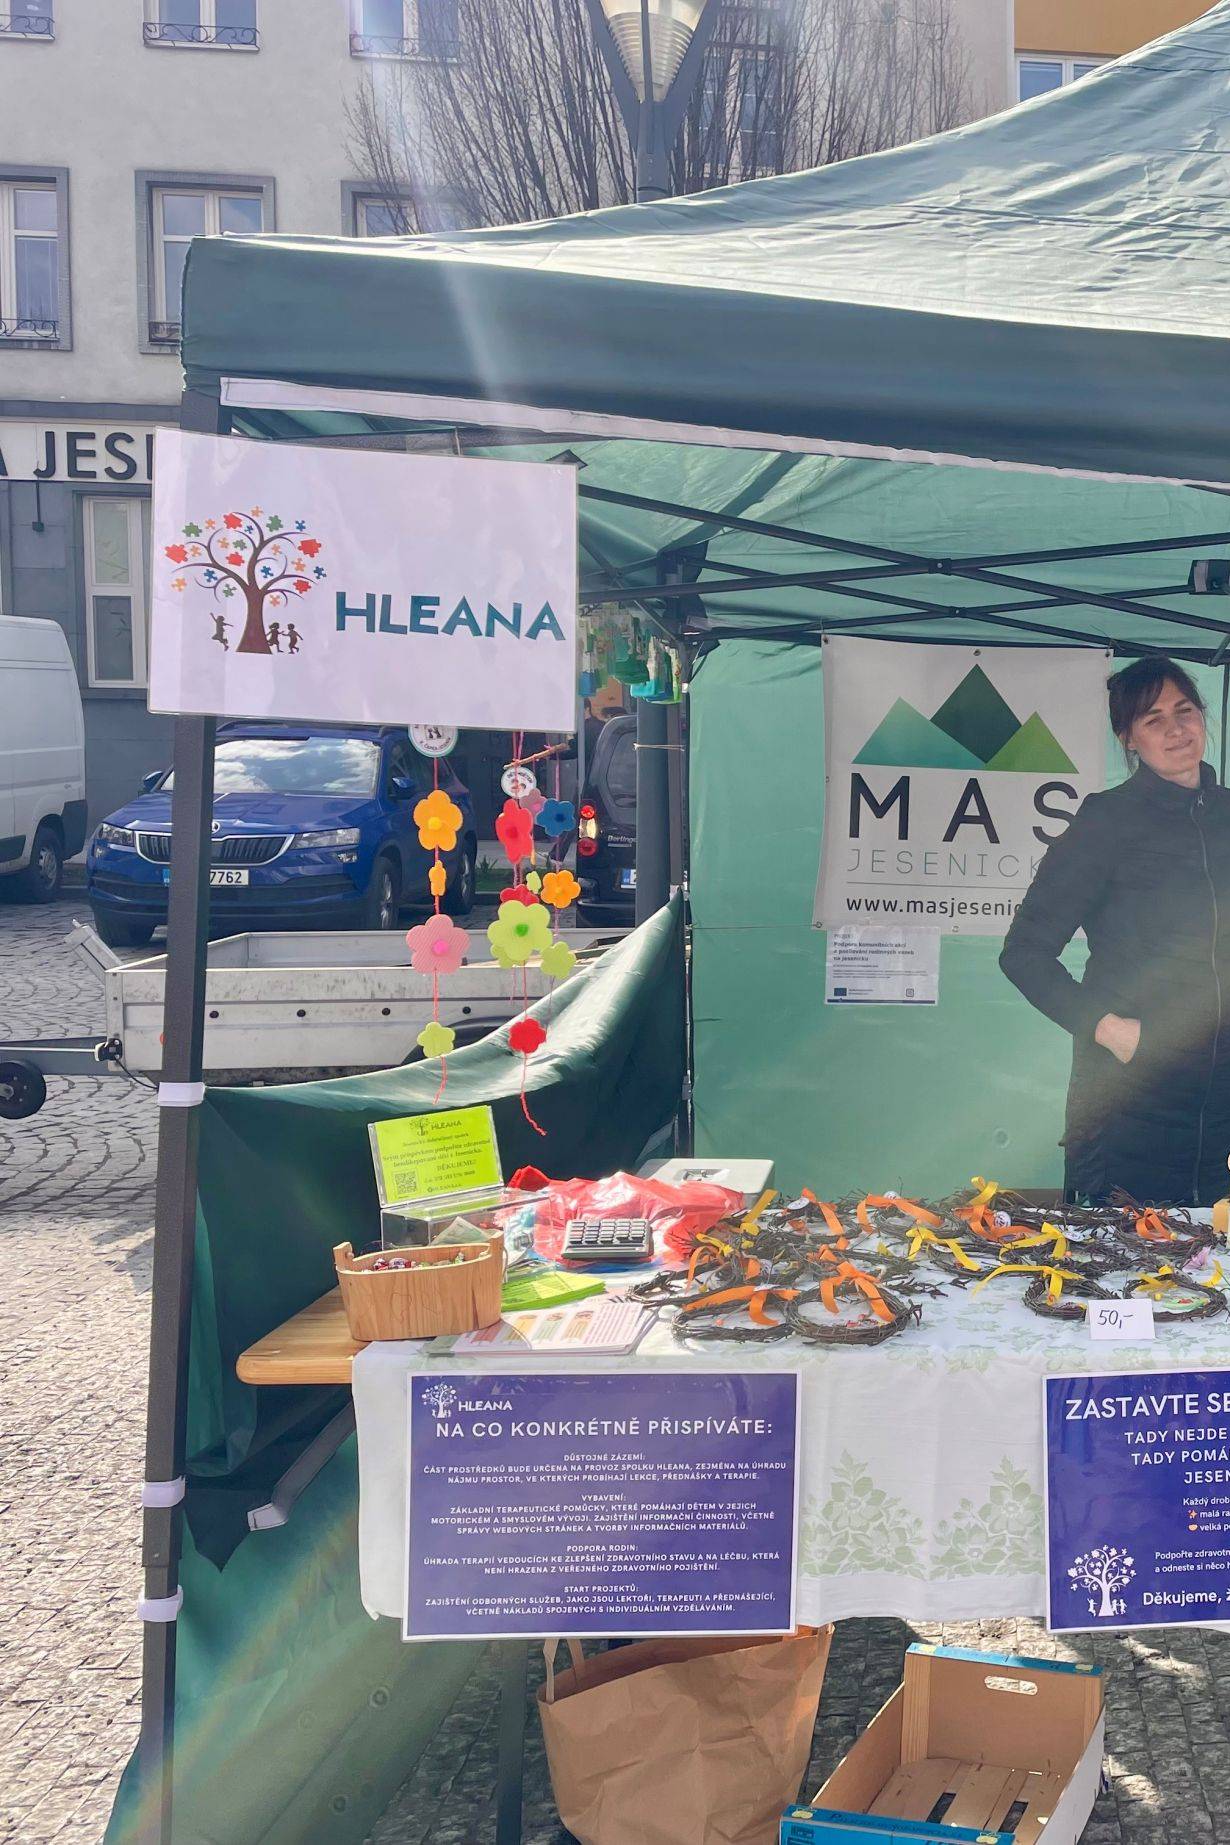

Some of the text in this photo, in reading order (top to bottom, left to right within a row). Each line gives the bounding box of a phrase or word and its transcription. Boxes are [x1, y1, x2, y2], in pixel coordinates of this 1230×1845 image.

[335, 592, 566, 641] HLEANA
[849, 772, 1079, 847] MAS
[210, 871, 242, 884] 7762
[458, 1400, 512, 1411] HLEANA
[1065, 1393, 1199, 1420] ZASTAVTE
[436, 1416, 772, 1437] NA CO KONKRÉTNĚ PŘISPÍVÁTE:
[1124, 1430, 1168, 1444] TADY
[1174, 1427, 1227, 1442] NEJDE
[564, 1452, 645, 1461] DŮSTOJNÉ ZÁZEMÍ:
[1131, 1451, 1175, 1465] TADY
[423, 1465, 446, 1473] ČÁST
[448, 1464, 505, 1473] PROSTŘEDKŮ
[533, 1464, 568, 1472] URČENA
[656, 1463, 692, 1473] HLEANA,
[695, 1461, 735, 1469] ZEJMÉNA
[752, 1460, 786, 1469] ÚHRADU
[581, 1492, 626, 1501] VYBAVENÍ:
[1183, 1497, 1208, 1507] Každý
[450, 1505, 494, 1514] ZÁKLADNÍ
[496, 1503, 560, 1512] TERAPEUTICKÉ
[563, 1503, 608, 1513] POMŮCKY,
[611, 1502, 638, 1511] KTERÉ
[640, 1502, 684, 1511] POMÁHAJÍ
[687, 1502, 716, 1510] DĚTEM
[726, 1502, 756, 1511] JEJICH
[1199, 1509, 1220, 1518] malá
[1199, 1522, 1222, 1531] velká
[566, 1544, 606, 1553] PODPORA
[1155, 1549, 1193, 1560] Podpořte
[423, 1557, 459, 1565] ÚHRADA
[461, 1556, 494, 1564] TERAPIÍ
[496, 1555, 548, 1564] VEDOUCÍCH
[550, 1555, 562, 1563] KE
[564, 1553, 604, 1562] ZLEPŠENÍ
[606, 1552, 667, 1561] ZDRAVOTNÍHO
[669, 1553, 695, 1561] STAVU
[719, 1551, 749, 1560] LÉČBU,
[752, 1551, 779, 1559] KTERÁ
[1161, 1563, 1194, 1572] odneste
[1196, 1562, 1203, 1570] si
[1205, 1561, 1225, 1570] něco
[564, 1583, 639, 1593] START PROJEKTŮ:
[425, 1597, 469, 1606] ZAJIŠTĚNÍ
[472, 1595, 526, 1604] ODBORNÝCH
[528, 1595, 563, 1605] SLUŽEB,
[566, 1595, 589, 1603] JAKO
[591, 1595, 614, 1603] JSOU
[616, 1593, 654, 1603] LEKTOŘI,
[657, 1594, 702, 1602] TERAPEUTI
[712, 1592, 775, 1601] PŘEDNÁŠEJÍCÍ,
[1143, 1590, 1222, 1606] Děkujeme,
[466, 1603, 735, 1615] VČETNĚ NÁKLADŮ SPOJENÝCH S INDIVIDUÁLNÍM VZDĚLÁVÁNÍM.
